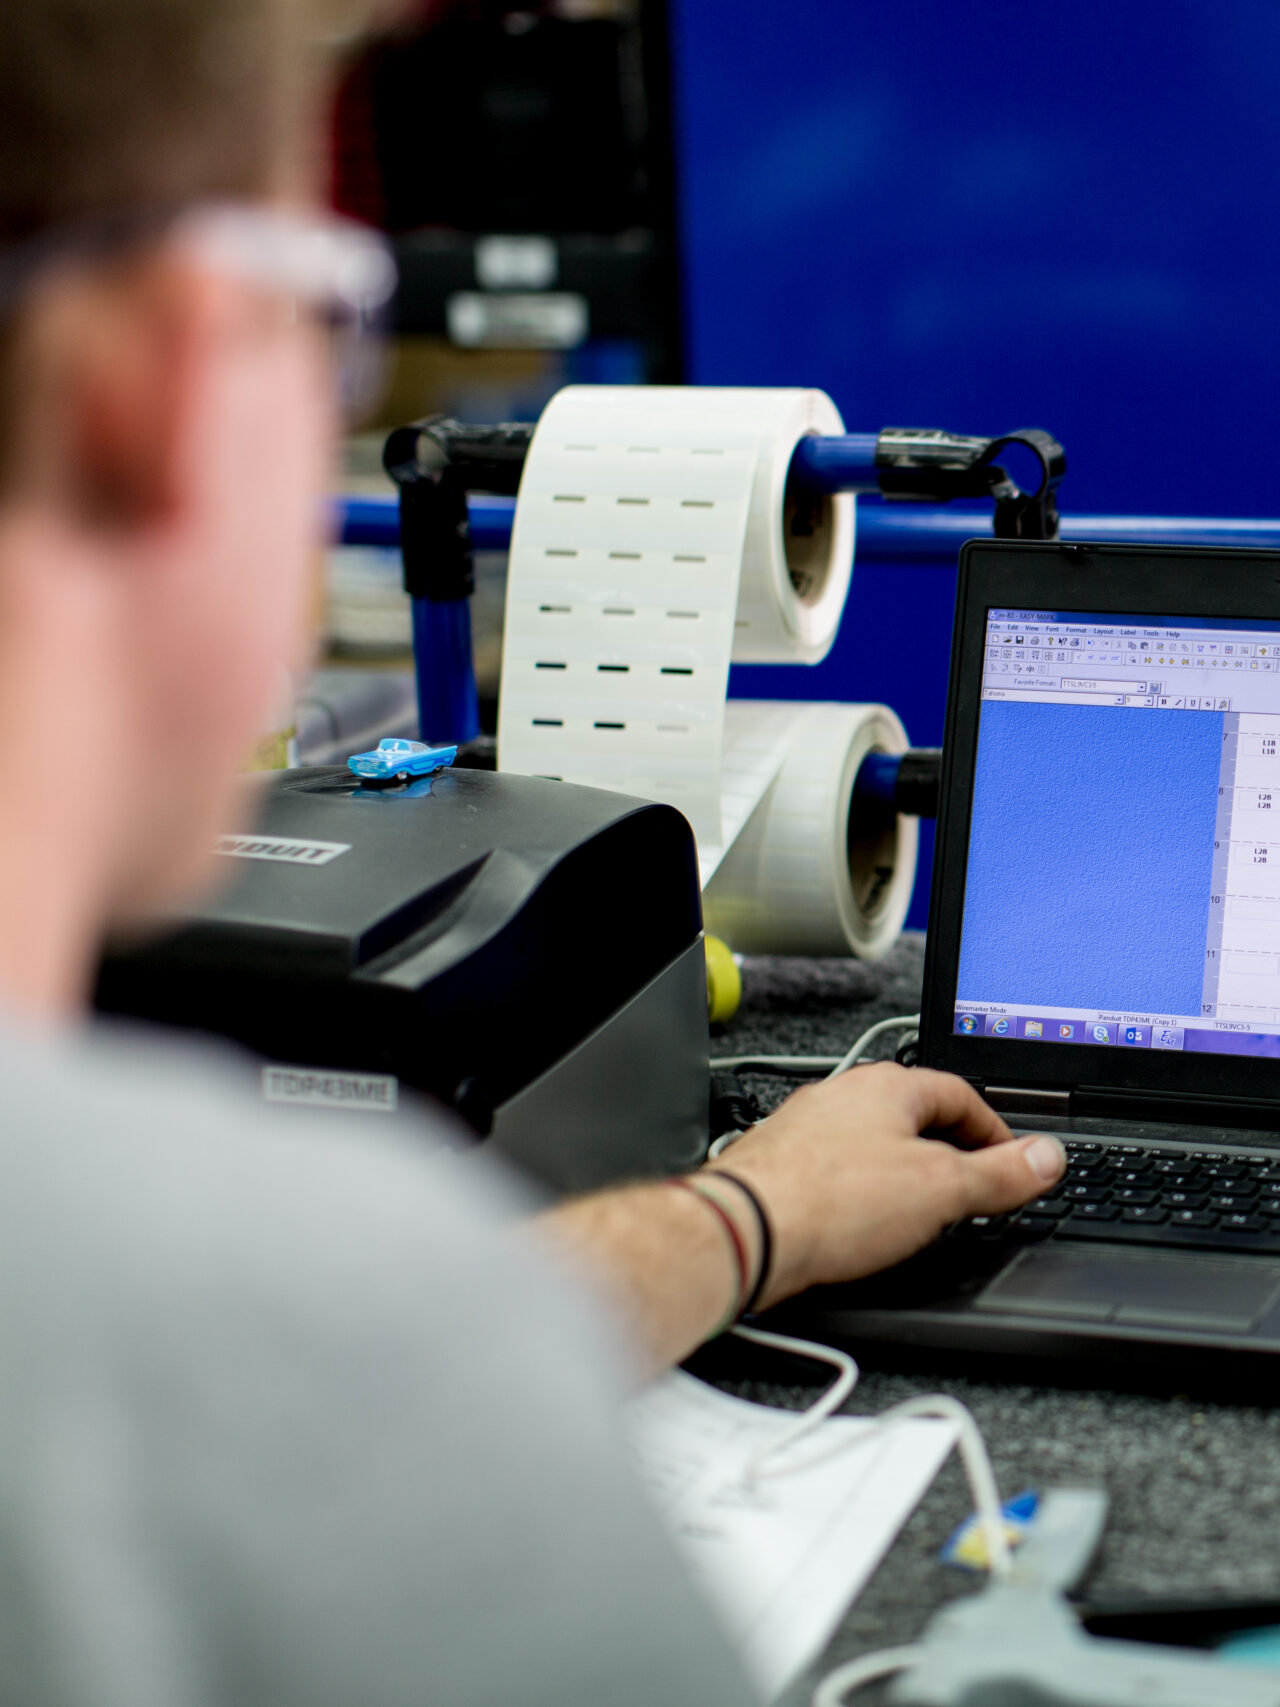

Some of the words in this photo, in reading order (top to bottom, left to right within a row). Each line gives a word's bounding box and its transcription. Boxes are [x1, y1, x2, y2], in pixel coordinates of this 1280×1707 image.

[1094, 628, 1114, 636] Layout
[1211, 896, 1220, 904] 10
[1206, 950, 1216, 958] 11
[956, 1004, 988, 1012] Wiremarker
[1100, 1014, 1122, 1022] Panduit
